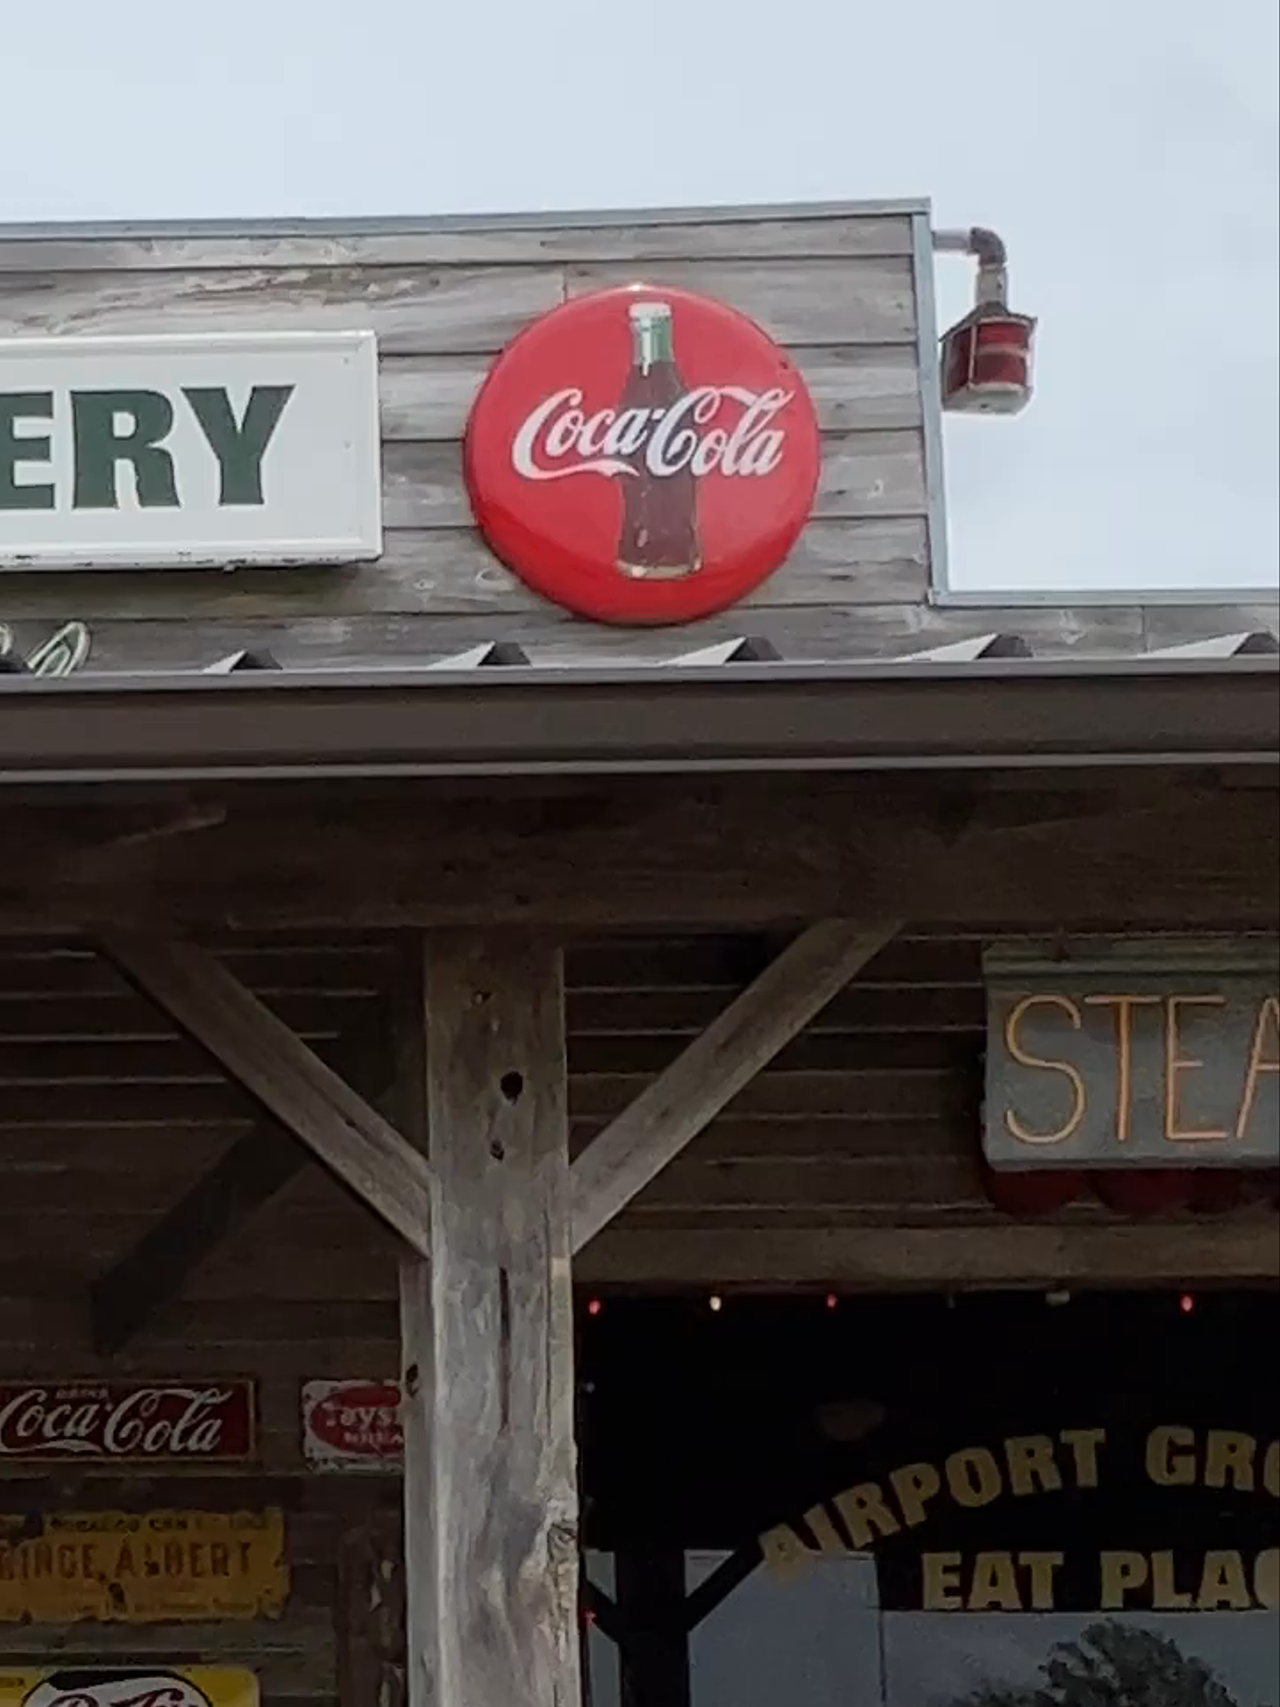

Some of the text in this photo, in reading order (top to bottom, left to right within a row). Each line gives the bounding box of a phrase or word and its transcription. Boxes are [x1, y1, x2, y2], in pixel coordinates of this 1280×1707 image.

[512, 385, 795, 480] Coca-Cola
[757, 1423, 1280, 1579] AIRPORT GR
[921, 1549, 1066, 1611] EAT
